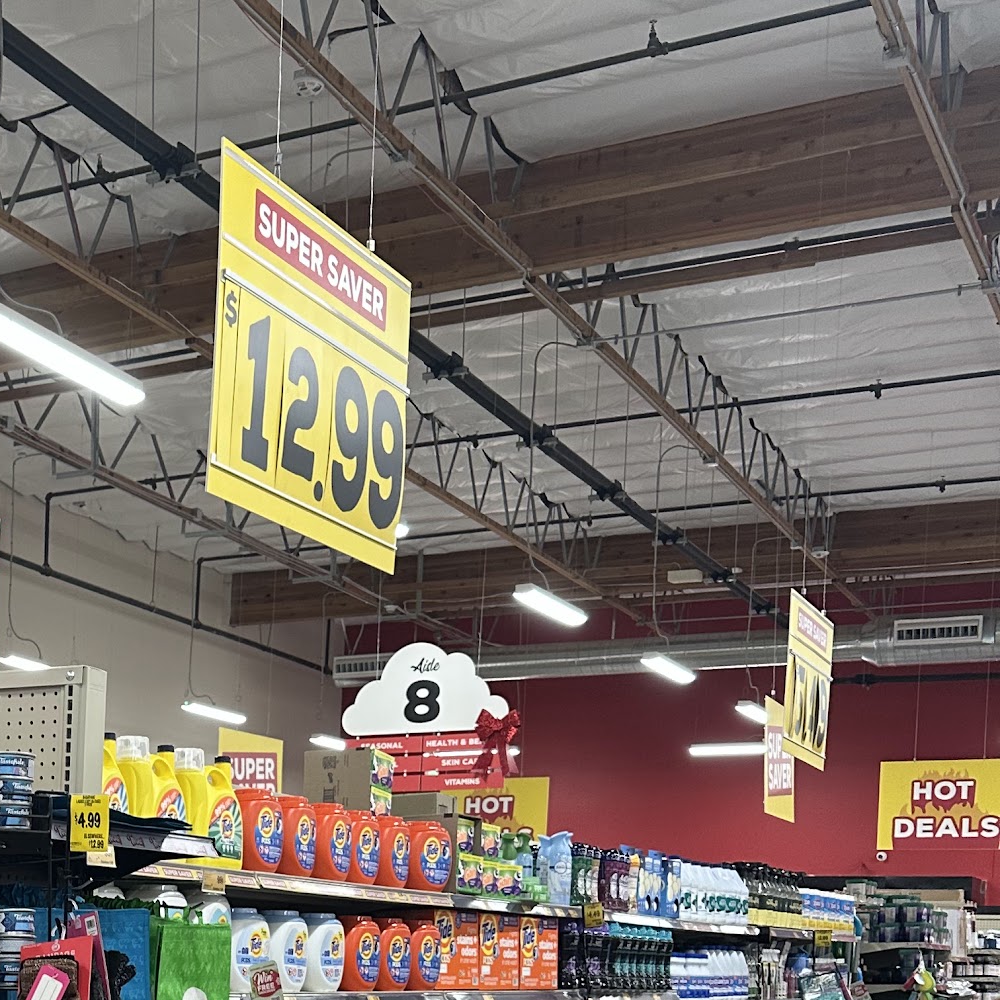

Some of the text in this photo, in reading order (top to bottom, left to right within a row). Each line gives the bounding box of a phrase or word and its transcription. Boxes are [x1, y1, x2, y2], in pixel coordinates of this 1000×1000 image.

[258, 201, 385, 322] SUPER SAVER
[224, 290, 402, 530] $12.99
[798, 614, 814, 639] SUPER
[410, 657, 440, 673] Aisle
[404, 680, 441, 724] 8
[425, 738, 467, 748] HEALTH &
[229, 755, 276, 781] SUPER
[441, 758, 460, 767] SKIN
[444, 777, 481, 786] VITAMINS
[768, 761, 792, 790] SAVER
[912, 780, 975, 800] HOT
[465, 796, 514, 814] HOT
[74, 812, 101, 829] $4.99
[893, 818, 1000, 838] DEALS
[482, 922, 495, 943] Tide
[254, 970, 273, 985] Win
[257, 982, 275, 991] FREE
